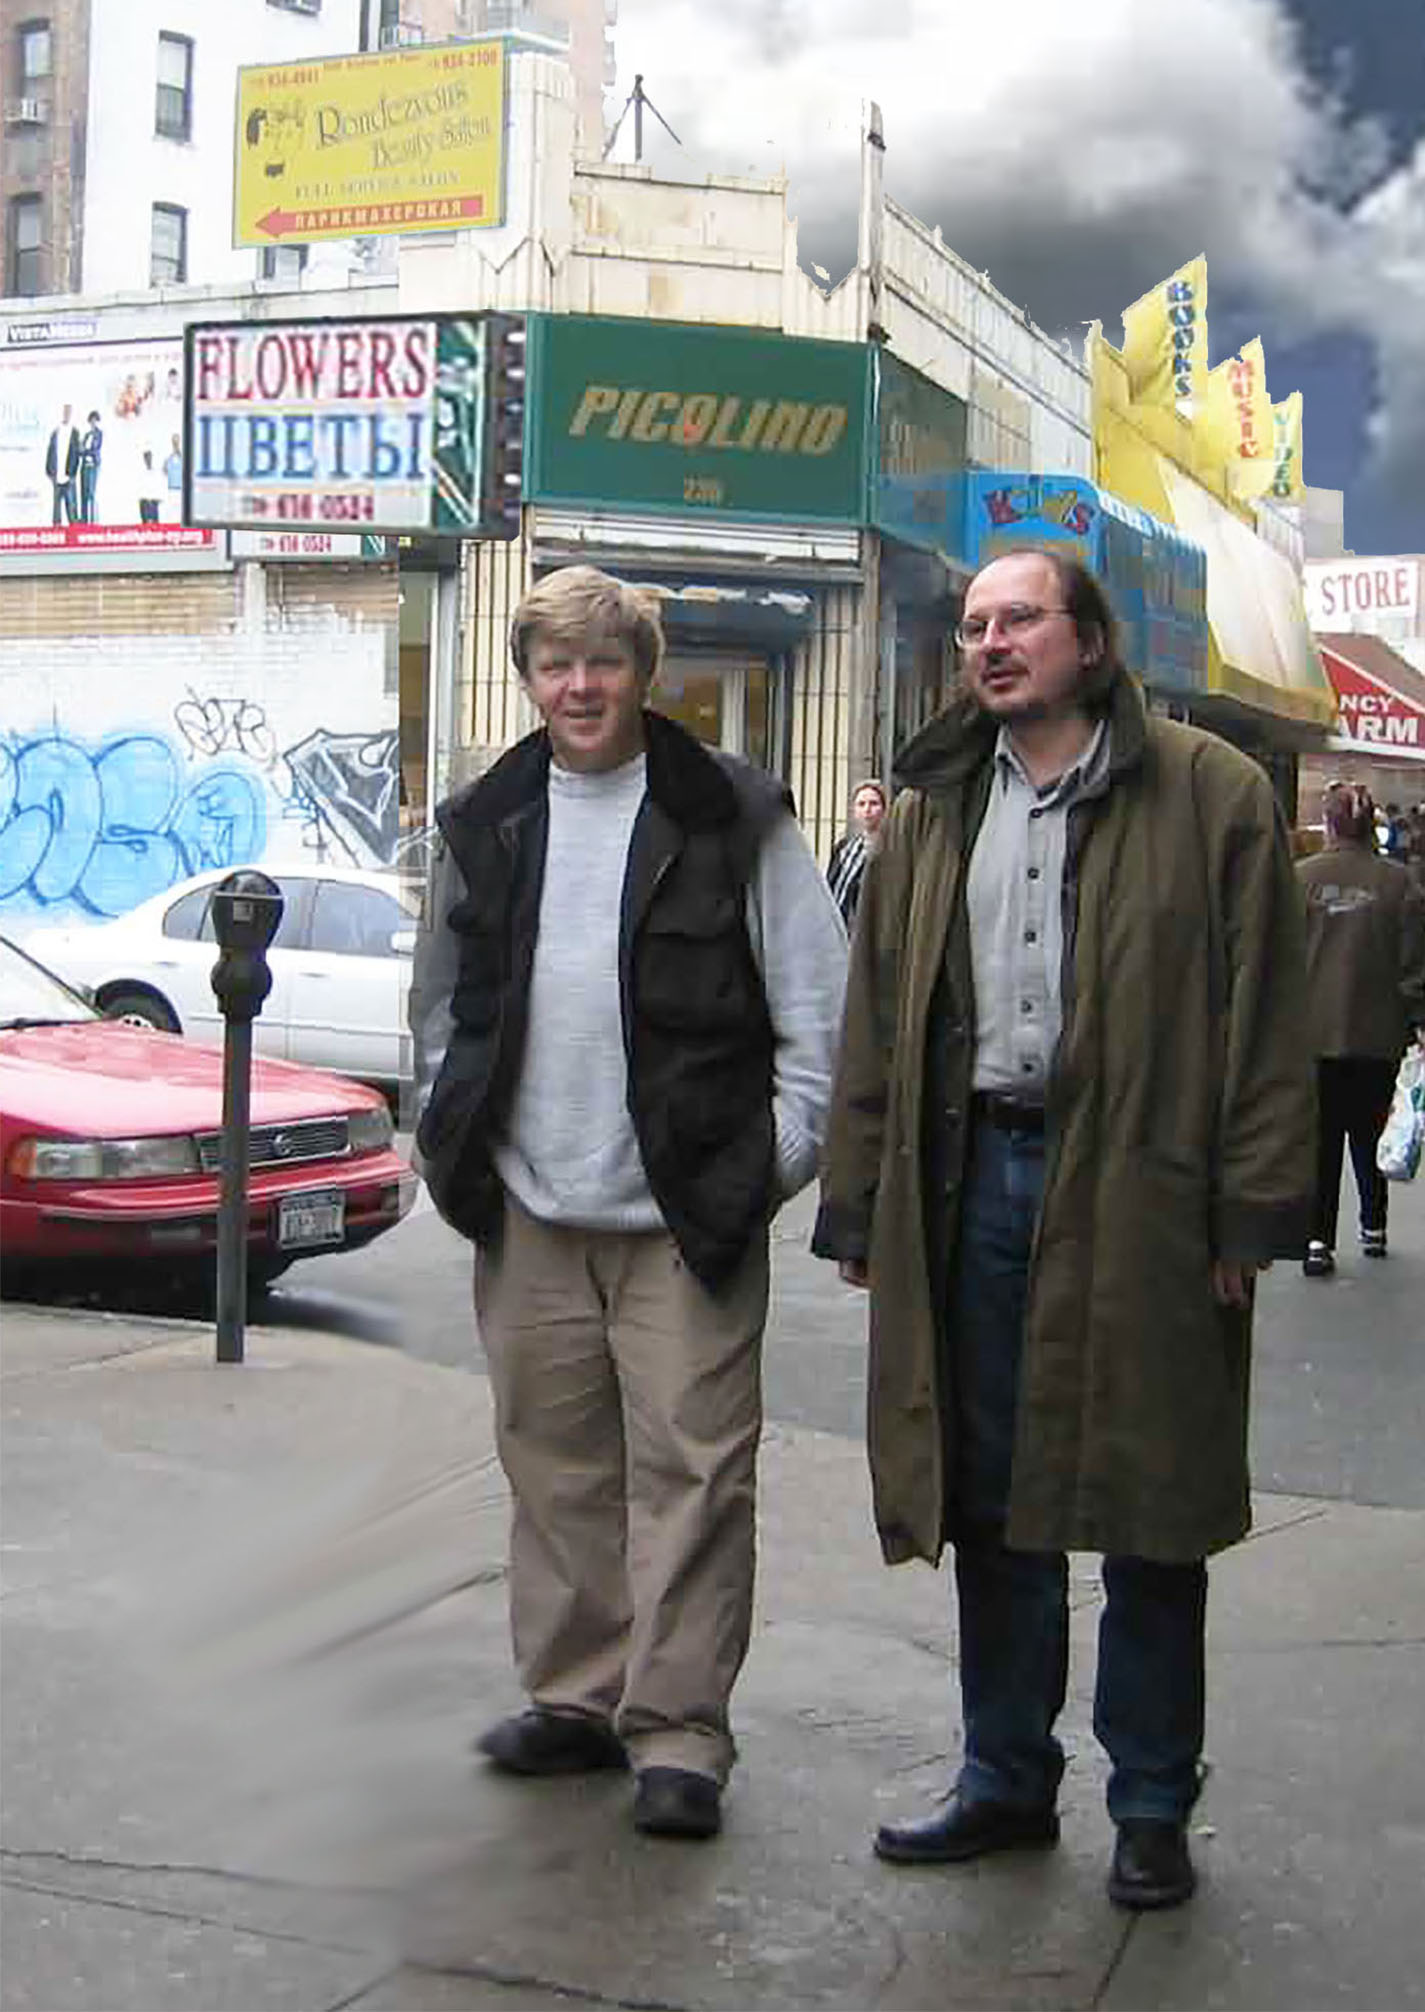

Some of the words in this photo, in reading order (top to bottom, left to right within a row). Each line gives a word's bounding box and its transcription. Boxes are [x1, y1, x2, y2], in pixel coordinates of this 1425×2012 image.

[294, 199, 463, 230] ПАРИКМАХЕРСКАЯ
[197, 329, 428, 400] FLOWERS
[196, 413, 426, 479] ЦВЕТЫ
[568, 384, 848, 456] PICOLINO
[1321, 569, 1411, 616] STORE
[1339, 693, 1396, 713] NCY
